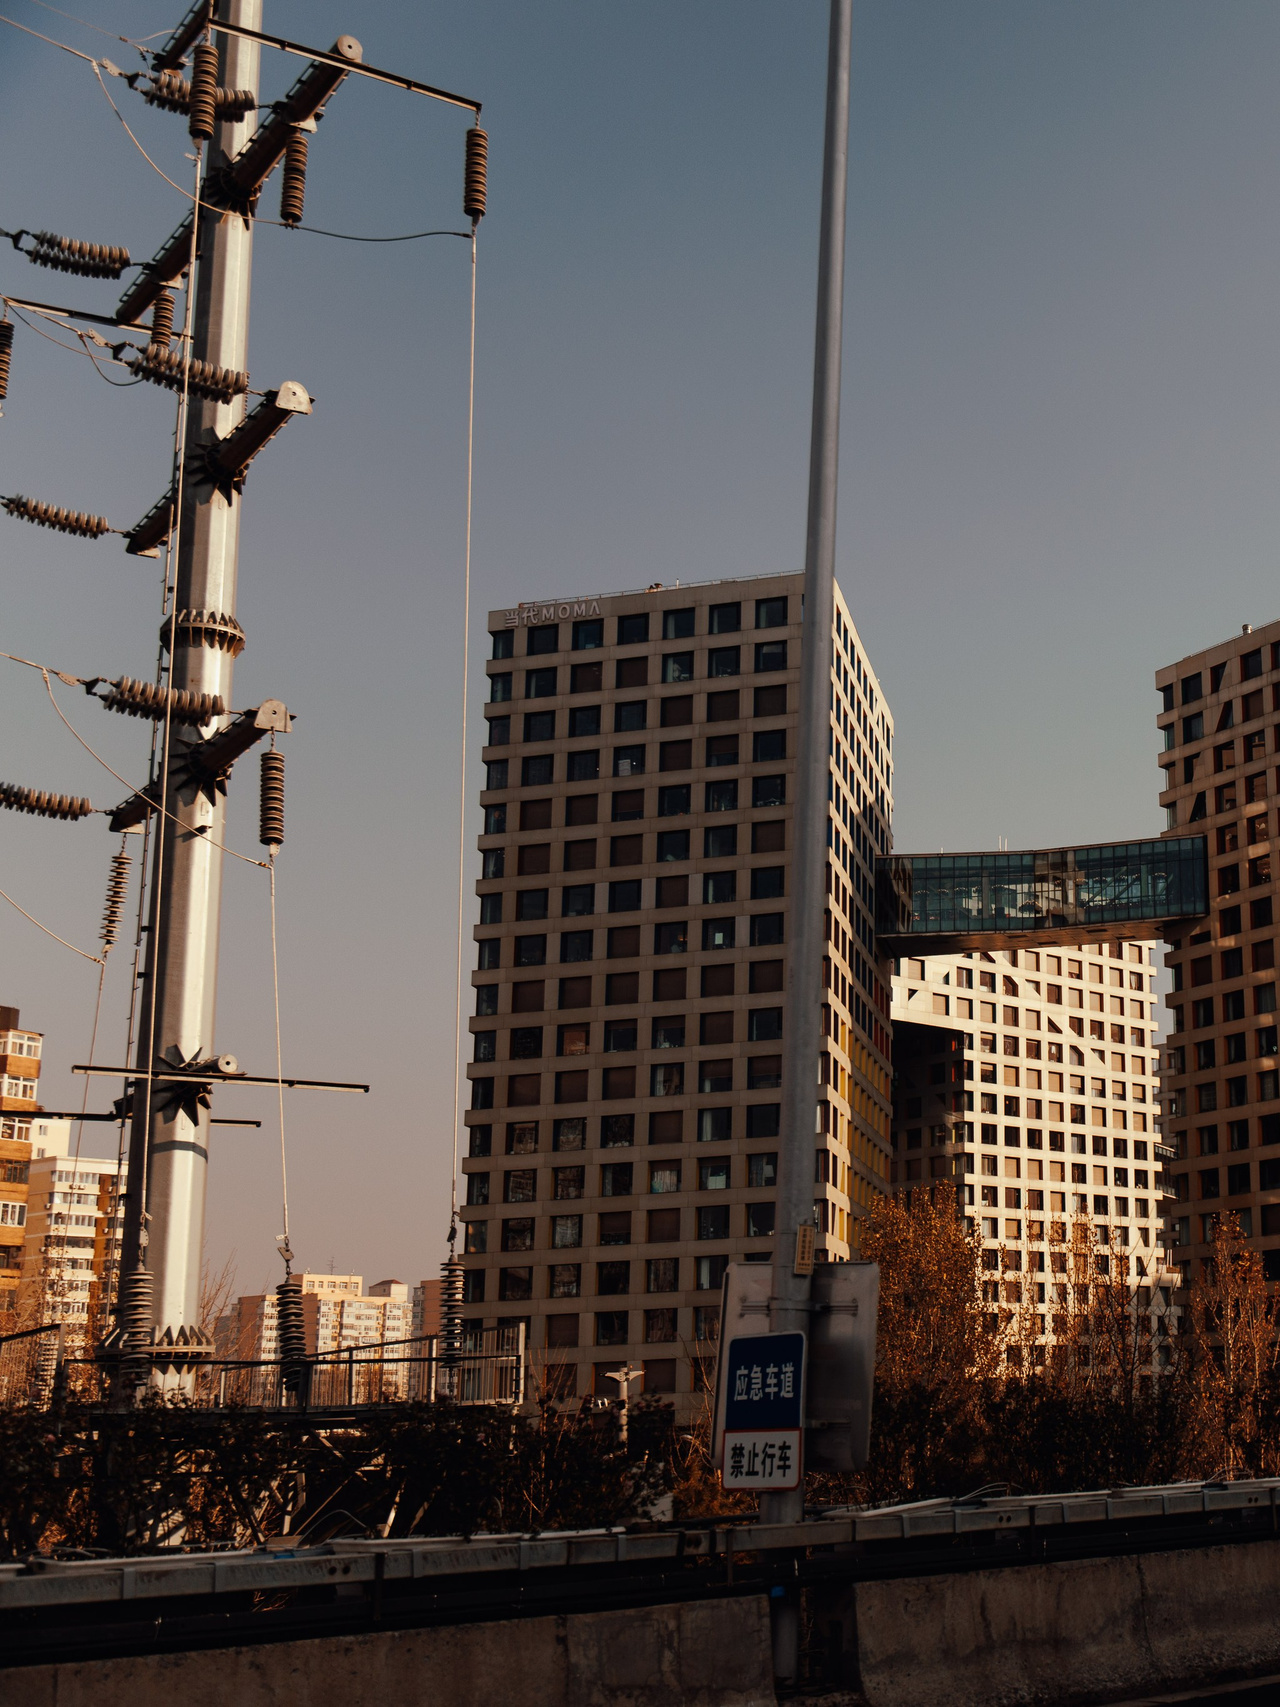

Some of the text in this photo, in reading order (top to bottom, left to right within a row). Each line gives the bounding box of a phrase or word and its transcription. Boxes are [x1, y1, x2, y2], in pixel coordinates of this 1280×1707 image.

[734, 1362, 795, 1402] 应急车道
[730, 1440, 792, 1479] 禁止行车
